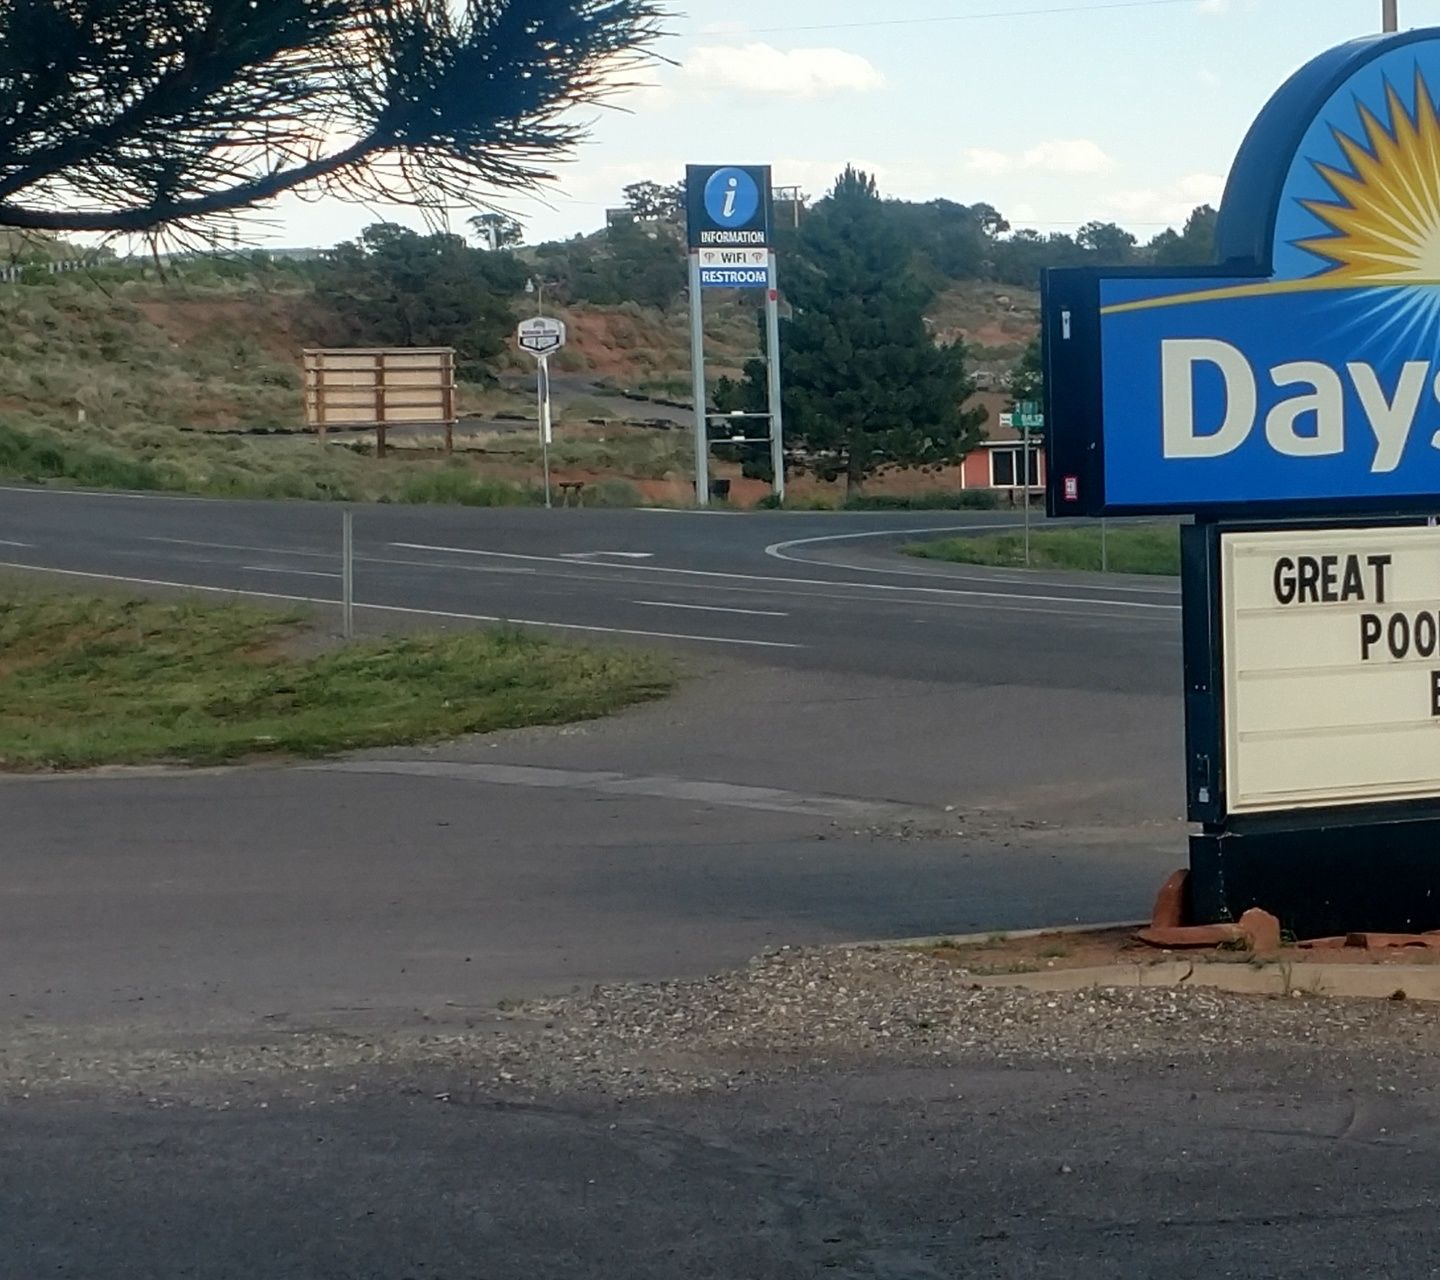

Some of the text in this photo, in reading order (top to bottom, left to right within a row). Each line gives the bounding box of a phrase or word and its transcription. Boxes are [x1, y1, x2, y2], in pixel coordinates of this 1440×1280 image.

[701, 231, 765, 243] INFORMATION
[721, 252, 746, 264] WIFI
[702, 271, 767, 282] RESTROOM
[1274, 554, 1392, 604] GREAT
